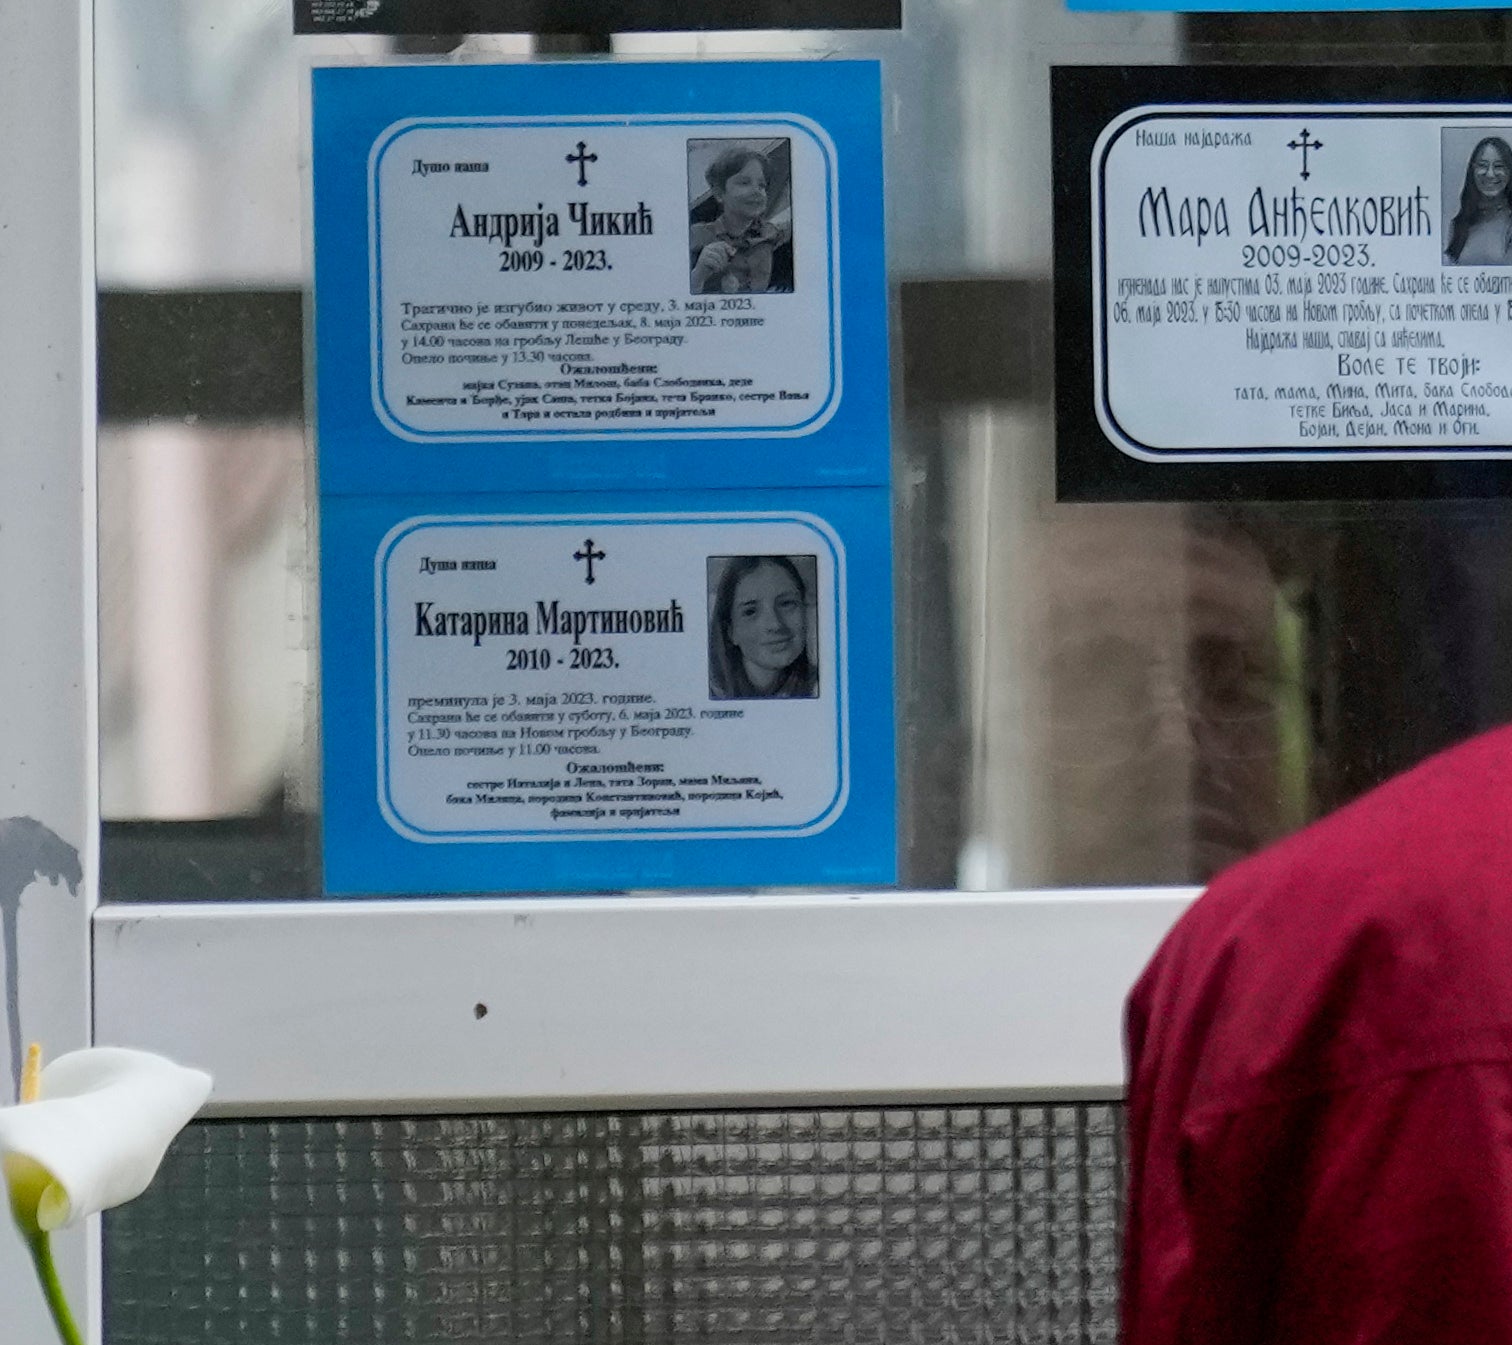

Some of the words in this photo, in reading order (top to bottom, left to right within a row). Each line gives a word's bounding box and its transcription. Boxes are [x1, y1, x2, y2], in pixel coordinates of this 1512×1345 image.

[1135, 128, 1176, 147] Наша
[1138, 186, 1229, 247] Мара
[1244, 185, 1431, 247] Анђелковић
[1242, 243, 1375, 269] 2009-2023.
[1337, 353, 1384, 377] Воле
[1395, 357, 1415, 376] те
